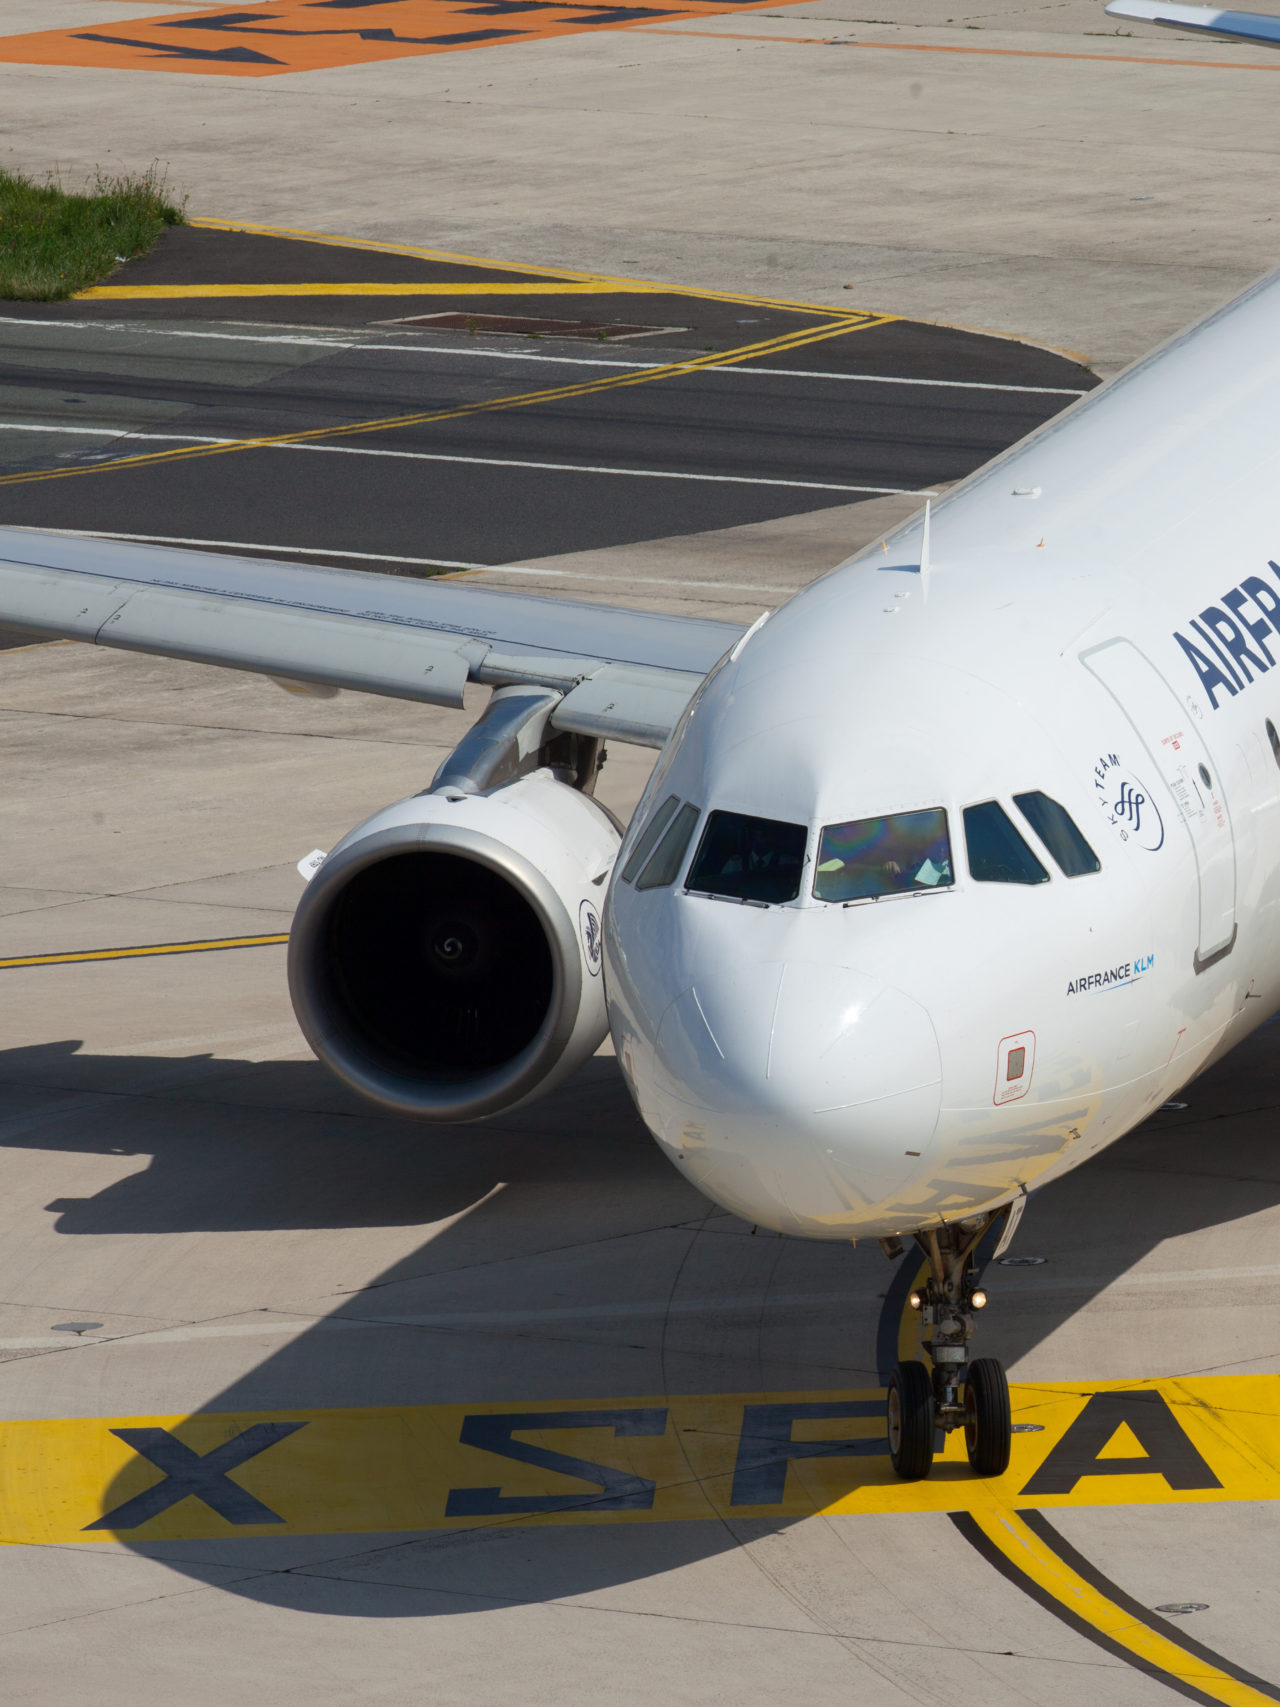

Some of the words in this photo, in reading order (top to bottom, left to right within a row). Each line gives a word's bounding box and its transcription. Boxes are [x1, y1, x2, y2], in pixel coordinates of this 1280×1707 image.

[1066, 962, 1131, 996] AIRFRANCE
[1133, 953, 1155, 975] KLM
[80, 1420, 311, 1531] X
